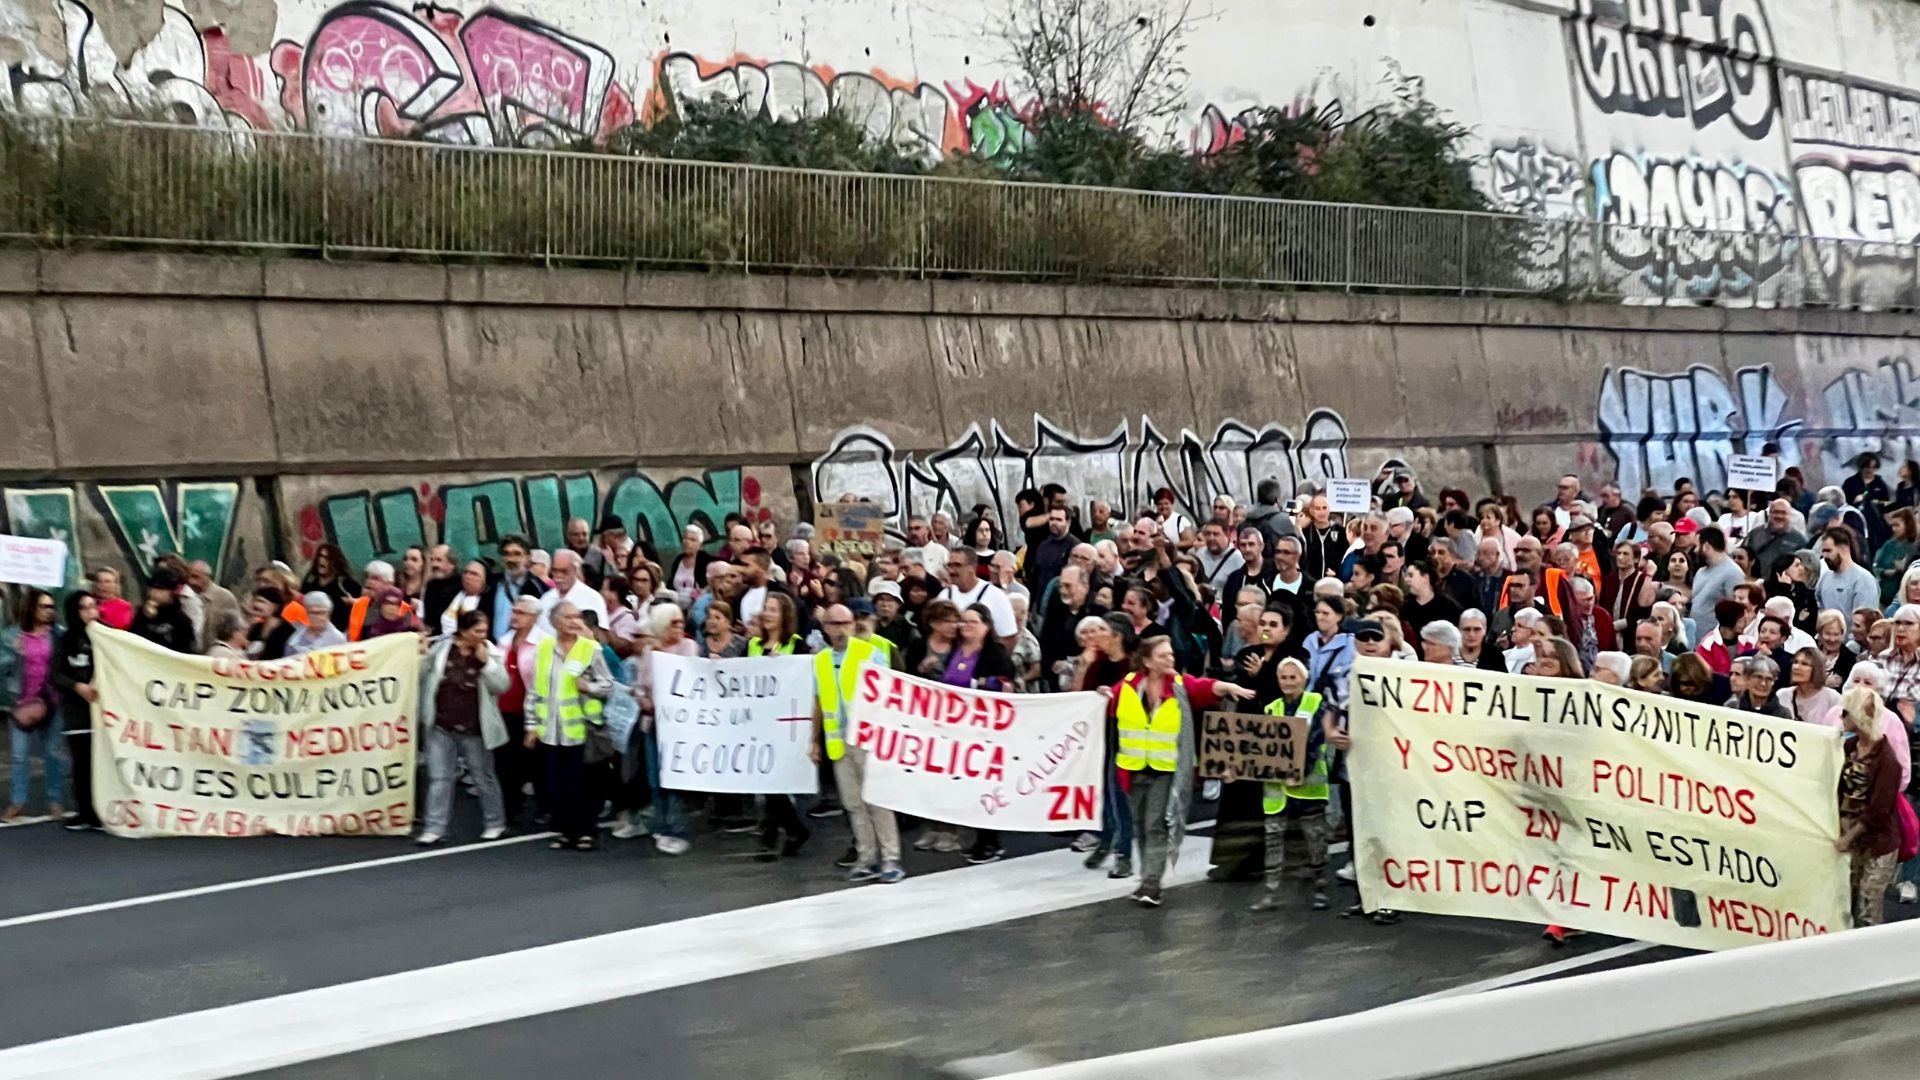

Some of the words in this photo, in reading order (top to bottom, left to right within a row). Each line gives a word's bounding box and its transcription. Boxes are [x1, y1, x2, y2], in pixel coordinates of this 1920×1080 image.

[212, 649, 368, 682] URGENTE
[670, 669, 707, 700] LA
[714, 669, 780, 699] SALUD
[144, 679, 217, 713] CAP
[226, 685, 311, 715] ZONA
[696, 706, 723, 727] ES
[729, 707, 753, 726] UN
[862, 668, 1017, 731] SANIDAD
[284, 713, 410, 759] MEDICOS
[1205, 714, 1231, 736] LA
[1235, 718, 1292, 740] SALUD
[1358, 673, 1403, 708] EN
[1410, 678, 1453, 715] ZN
[1462, 681, 1602, 727] FALTAN
[1611, 697, 1798, 769] SANITARIOS
[855, 721, 1005, 782] PUBLICA
[979, 786, 1010, 816] DE
[1015, 719, 1091, 797] CALIDAD
[1205, 738, 1235, 754] NO
[1239, 739, 1263, 755] ES
[1265, 741, 1294, 760] UN
[132, 760, 184, 792] NO
[192, 768, 239, 800] ES
[246, 767, 355, 801] CULPA
[362, 762, 408, 796] DE
[1393, 736, 1411, 770] Y
[1431, 739, 1564, 788] SOBRAN
[1592, 758, 1757, 825] POLITICOS
[1046, 784, 1097, 821] ZN
[1415, 797, 1486, 833] CAP
[1518, 805, 1561, 843] ZN
[1585, 817, 1633, 853] EN
[1645, 830, 1780, 889] ESTADO
[1383, 858, 1522, 898] CRITICO
[1526, 864, 1669, 920] FALTAN
[1707, 895, 1828, 941] MEDICO
